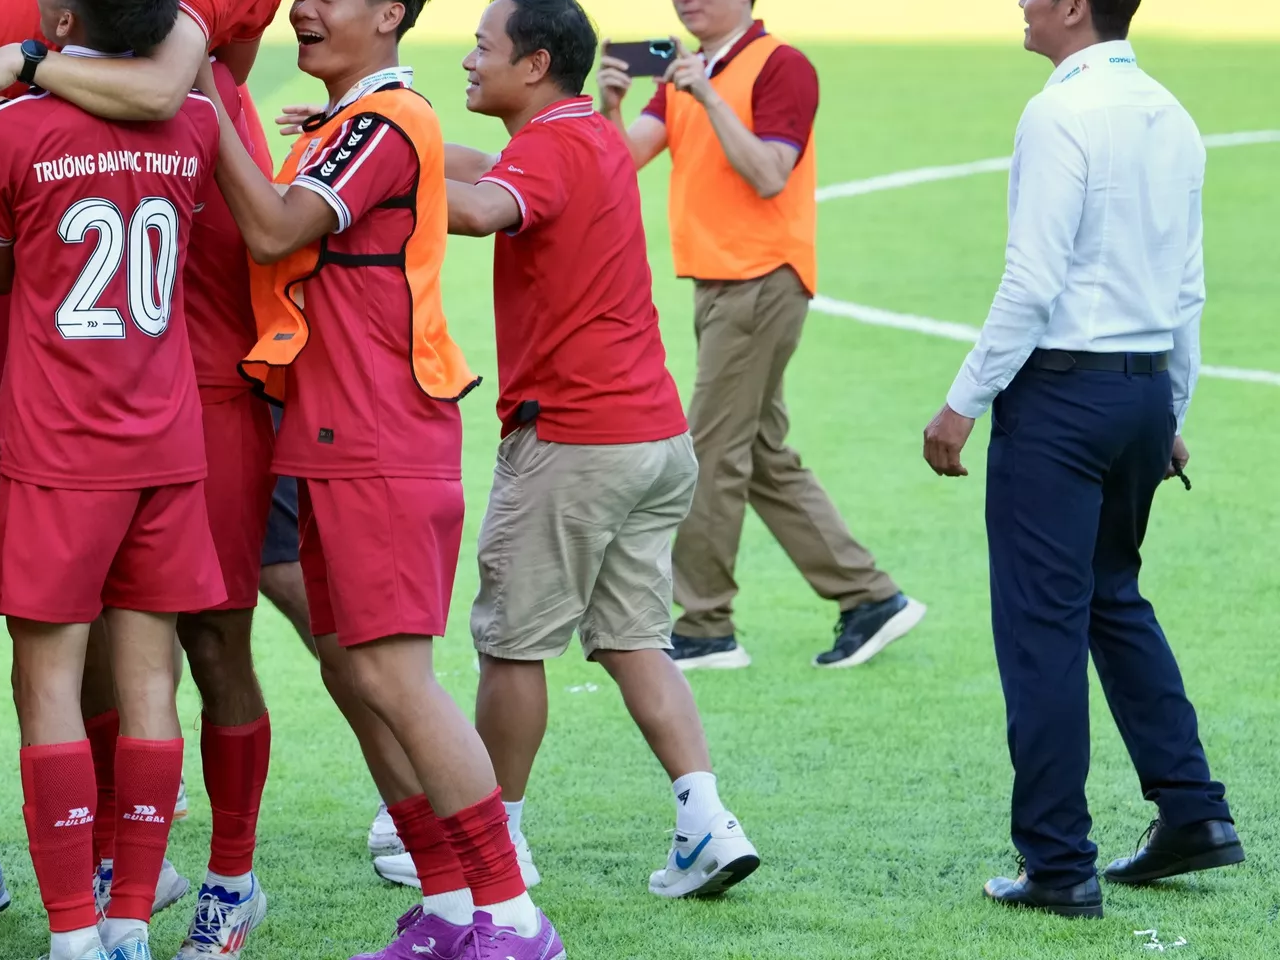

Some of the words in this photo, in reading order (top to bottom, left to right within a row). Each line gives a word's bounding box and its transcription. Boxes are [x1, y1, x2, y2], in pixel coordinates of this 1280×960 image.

[33, 153, 95, 183] TRƯỜNG
[98, 150, 119, 177] ĐẠI
[144, 150, 181, 176] THUỶ
[55, 197, 179, 339] 20
[123, 813, 165, 823] BULBAL
